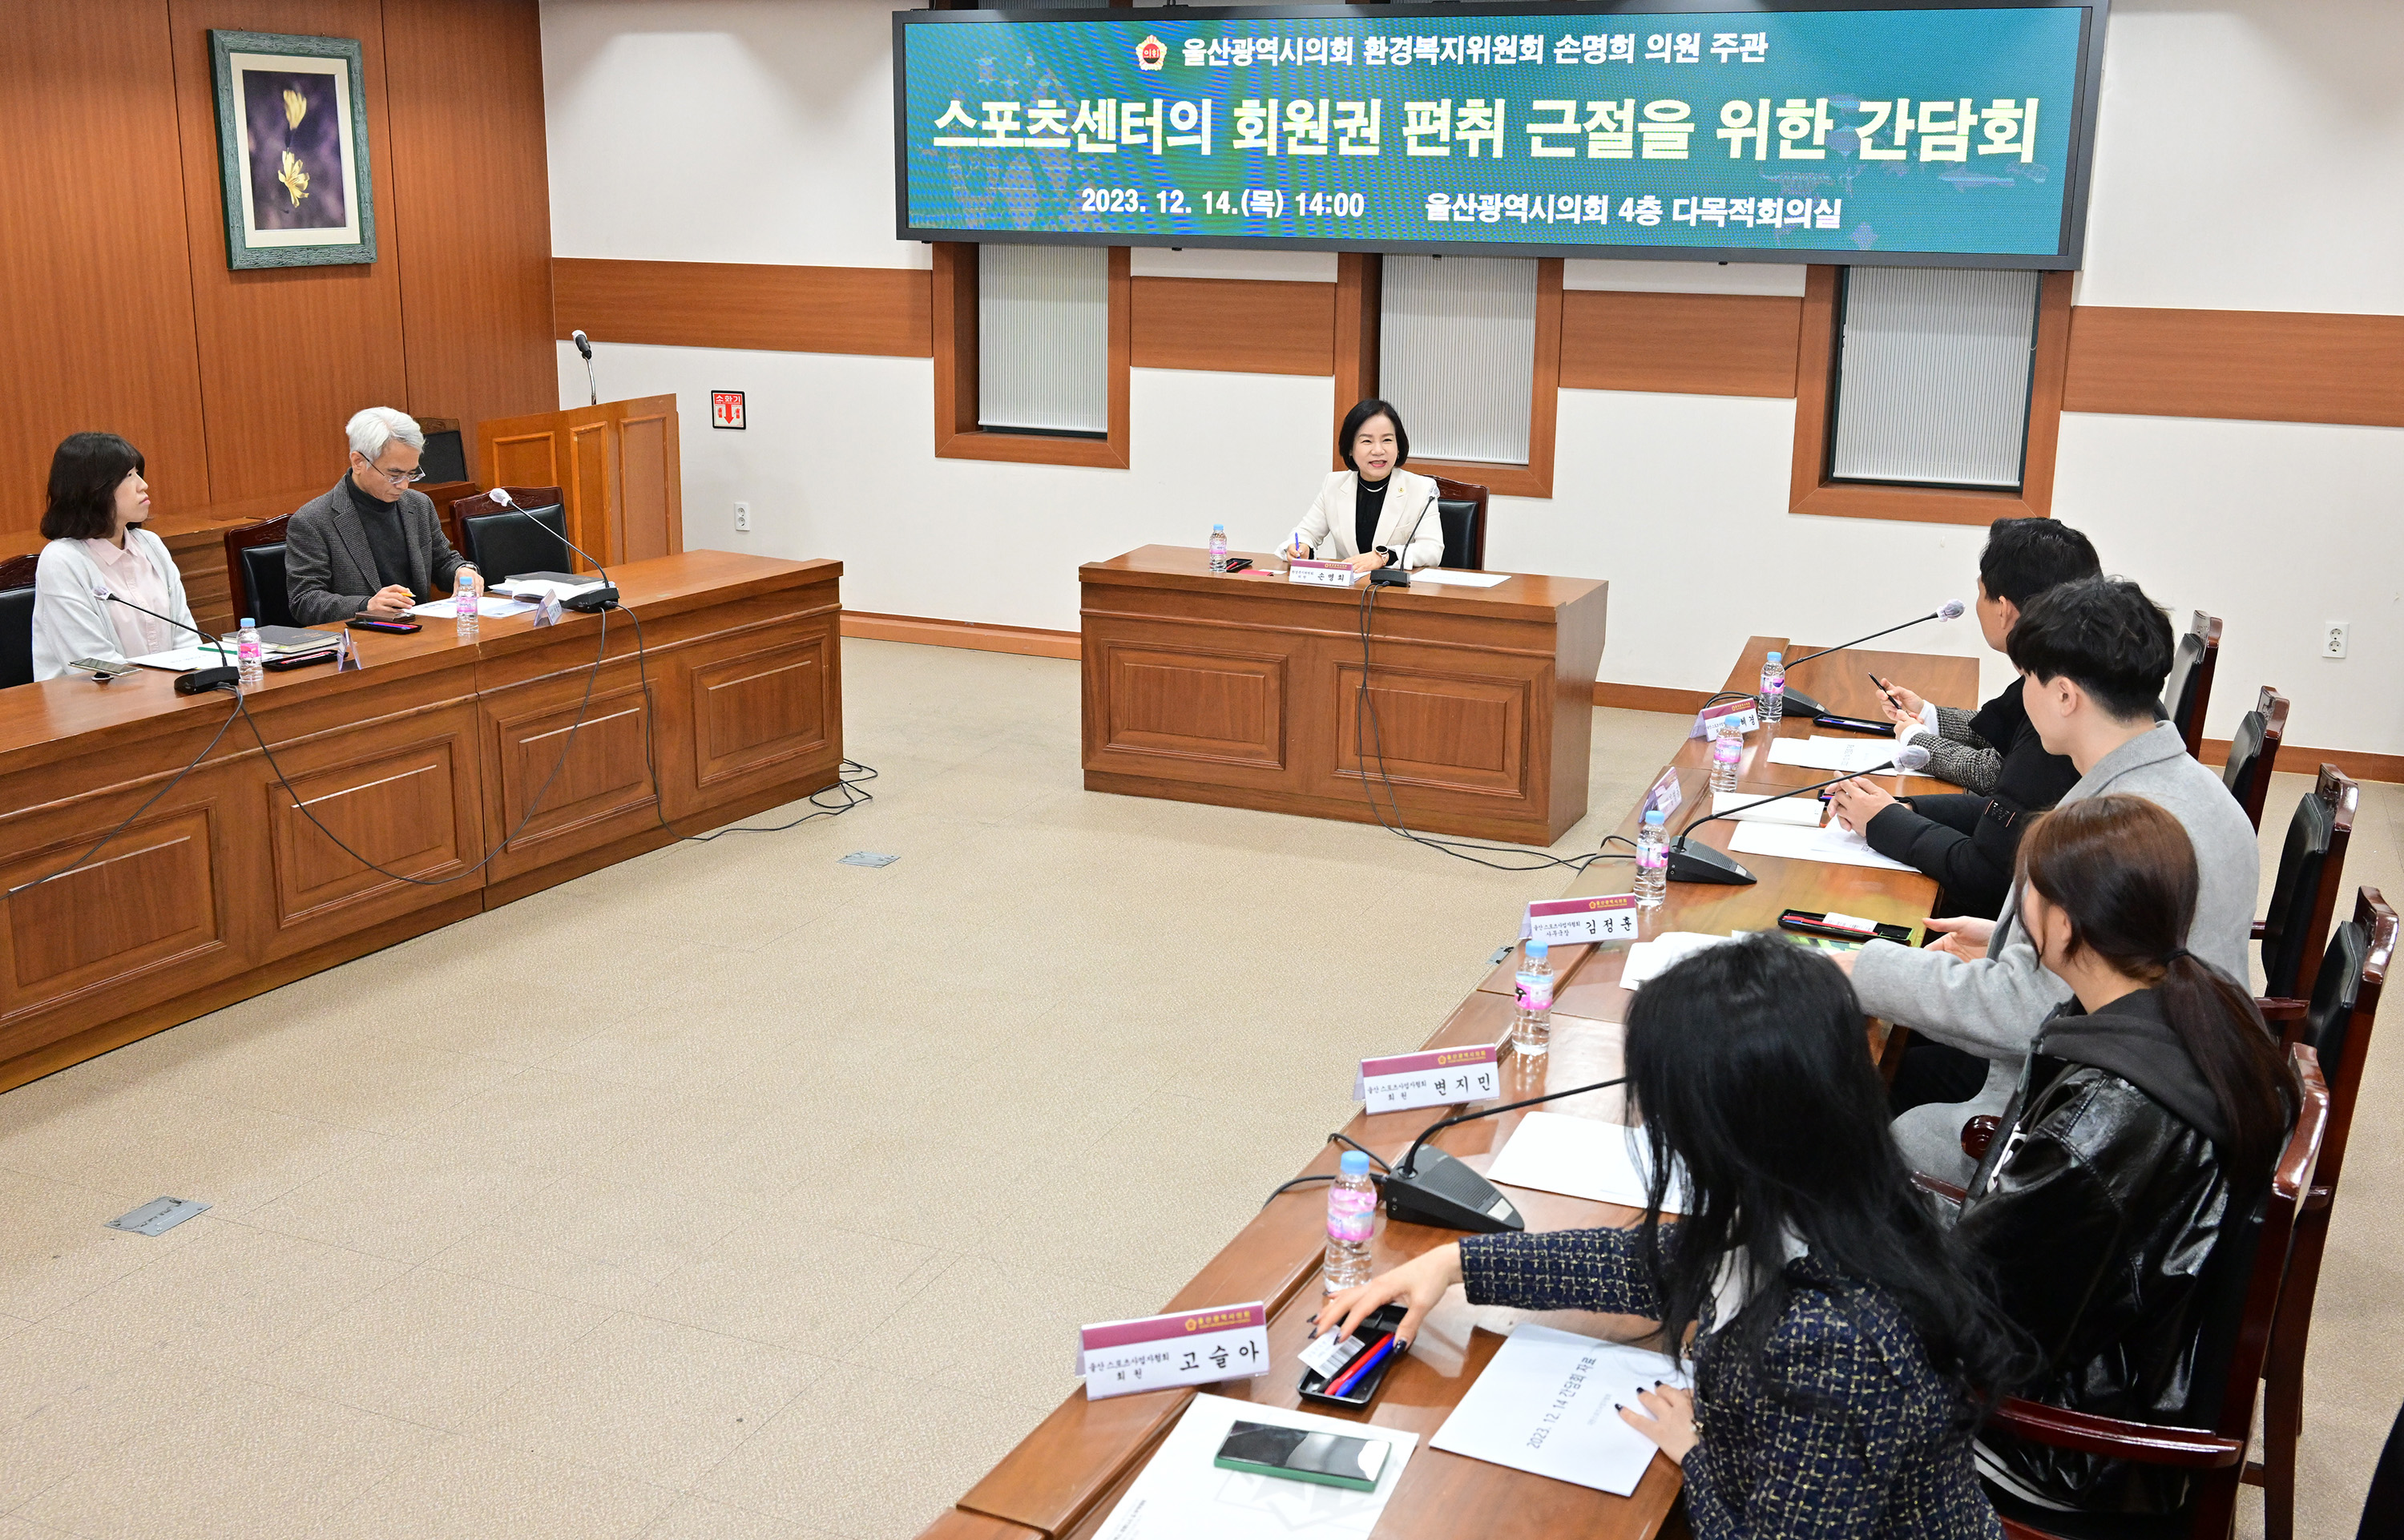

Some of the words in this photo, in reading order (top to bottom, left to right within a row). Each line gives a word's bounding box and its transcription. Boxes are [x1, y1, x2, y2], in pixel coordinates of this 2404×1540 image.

[1183, 37, 1353, 67] 울산광역시의회
[1363, 35, 1544, 66] 환경복지위원회
[1553, 33, 1636, 64] 손명희
[1644, 33, 1701, 63] 의원
[1709, 32, 1769, 63] 주관
[933, 98, 1212, 155] 스포츠센터의
[1232, 98, 1382, 156] 회원권
[1402, 98, 1506, 159] 편취
[1526, 98, 1696, 159] 근절을
[1716, 97, 1834, 161] 위한
[1854, 97, 2040, 163] 간담회
[1081, 188, 1146, 213] 2023.
[1156, 190, 1192, 214] 12.
[1295, 192, 1365, 217] 14:00
[1425, 192, 1609, 225] 울산광역시의회
[1618, 195, 1664, 226] 4층
[1672, 196, 1842, 229] 다목적회의실
[716, 394, 741, 402] 소화기
[1575, 1357, 1597, 1373] 자료
[1559, 1373, 1587, 1398] 간담회
[1553, 1398, 1569, 1410] 14
[1543, 1413, 1561, 1424] 12.
[1527, 1427, 1551, 1449] 2023.
